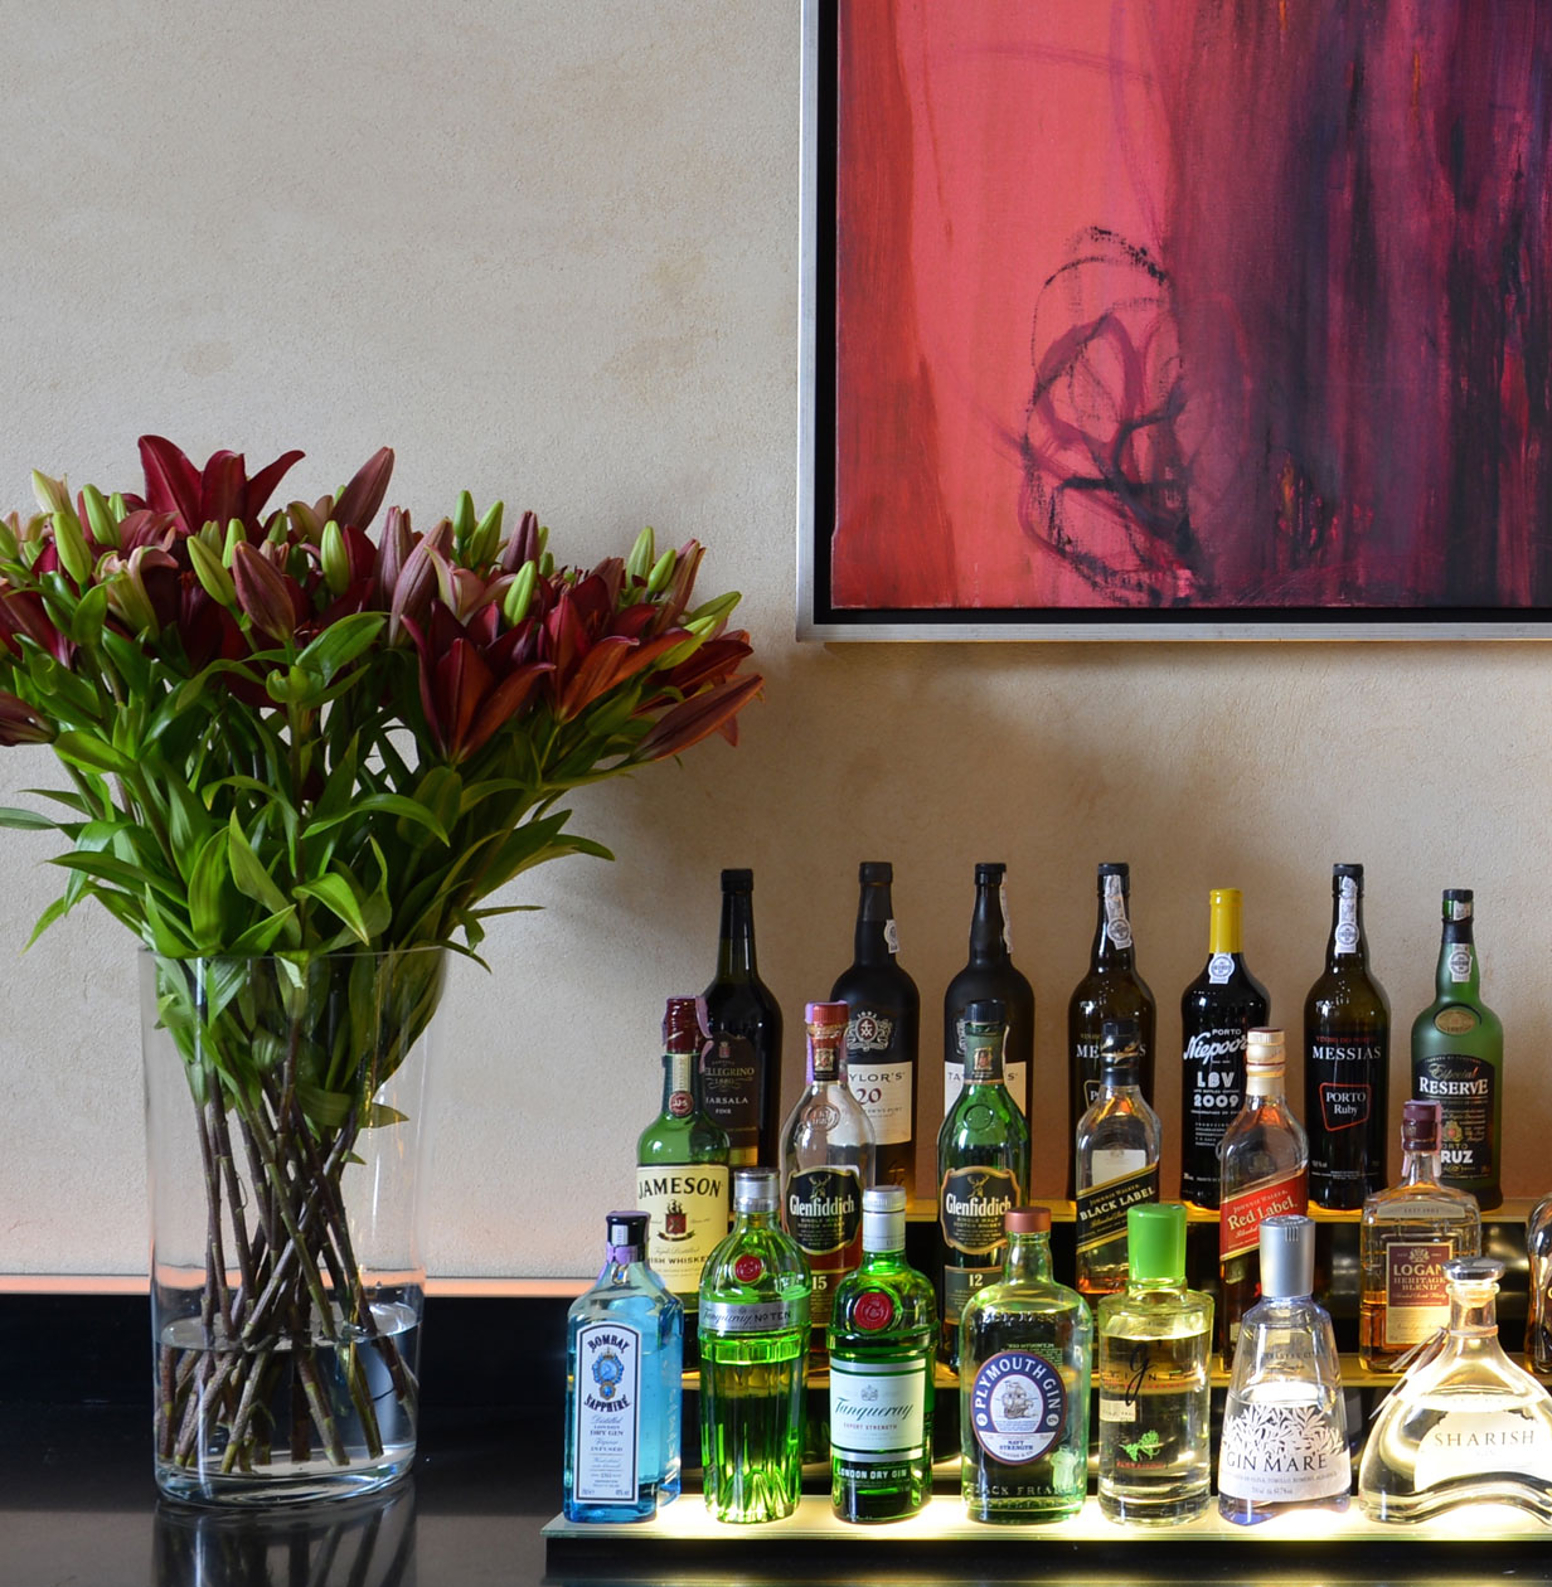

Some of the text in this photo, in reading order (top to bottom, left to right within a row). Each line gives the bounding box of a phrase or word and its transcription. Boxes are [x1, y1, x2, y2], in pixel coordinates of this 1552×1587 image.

[1183, 1031, 1248, 1065] Niepoor
[1312, 1045, 1381, 1060] MESSIAS
[705, 1067, 754, 1077] ELLEGRINO
[850, 1071, 904, 1082] YLOR'S
[1197, 1071, 1235, 1088] LBV
[1419, 1077, 1488, 1095] RESERVE
[857, 1088, 882, 1105] 20
[1193, 1094, 1239, 1108] 2009
[1326, 1091, 1366, 1102] PORTO
[1334, 1104, 1358, 1116] Ruby
[1440, 1149, 1474, 1164] RUZ
[638, 1177, 721, 1199] JAMESON
[789, 1194, 855, 1217] Glenfiddich
[945, 1193, 1012, 1217] Glenfiddich
[1080, 1200, 1118, 1221] BLACK
[1119, 1186, 1156, 1206] LABEL
[1227, 1210, 1257, 1231] Red
[812, 1276, 828, 1290] 15
[969, 1273, 983, 1287] 12
[770, 1310, 792, 1321] TEN
[587, 1334, 630, 1354] BOMBAY
[975, 1357, 1047, 1409] PLYMOUTH
[1043, 1378, 1062, 1409] GIN
[584, 1393, 631, 1413] SAPPHIRE
[835, 1397, 914, 1421] Tanqueray
[1434, 1430, 1534, 1447] SHARISH
[1227, 1451, 1328, 1472] GIN MARE
[839, 1467, 907, 1480] LONDON DRY GIN
